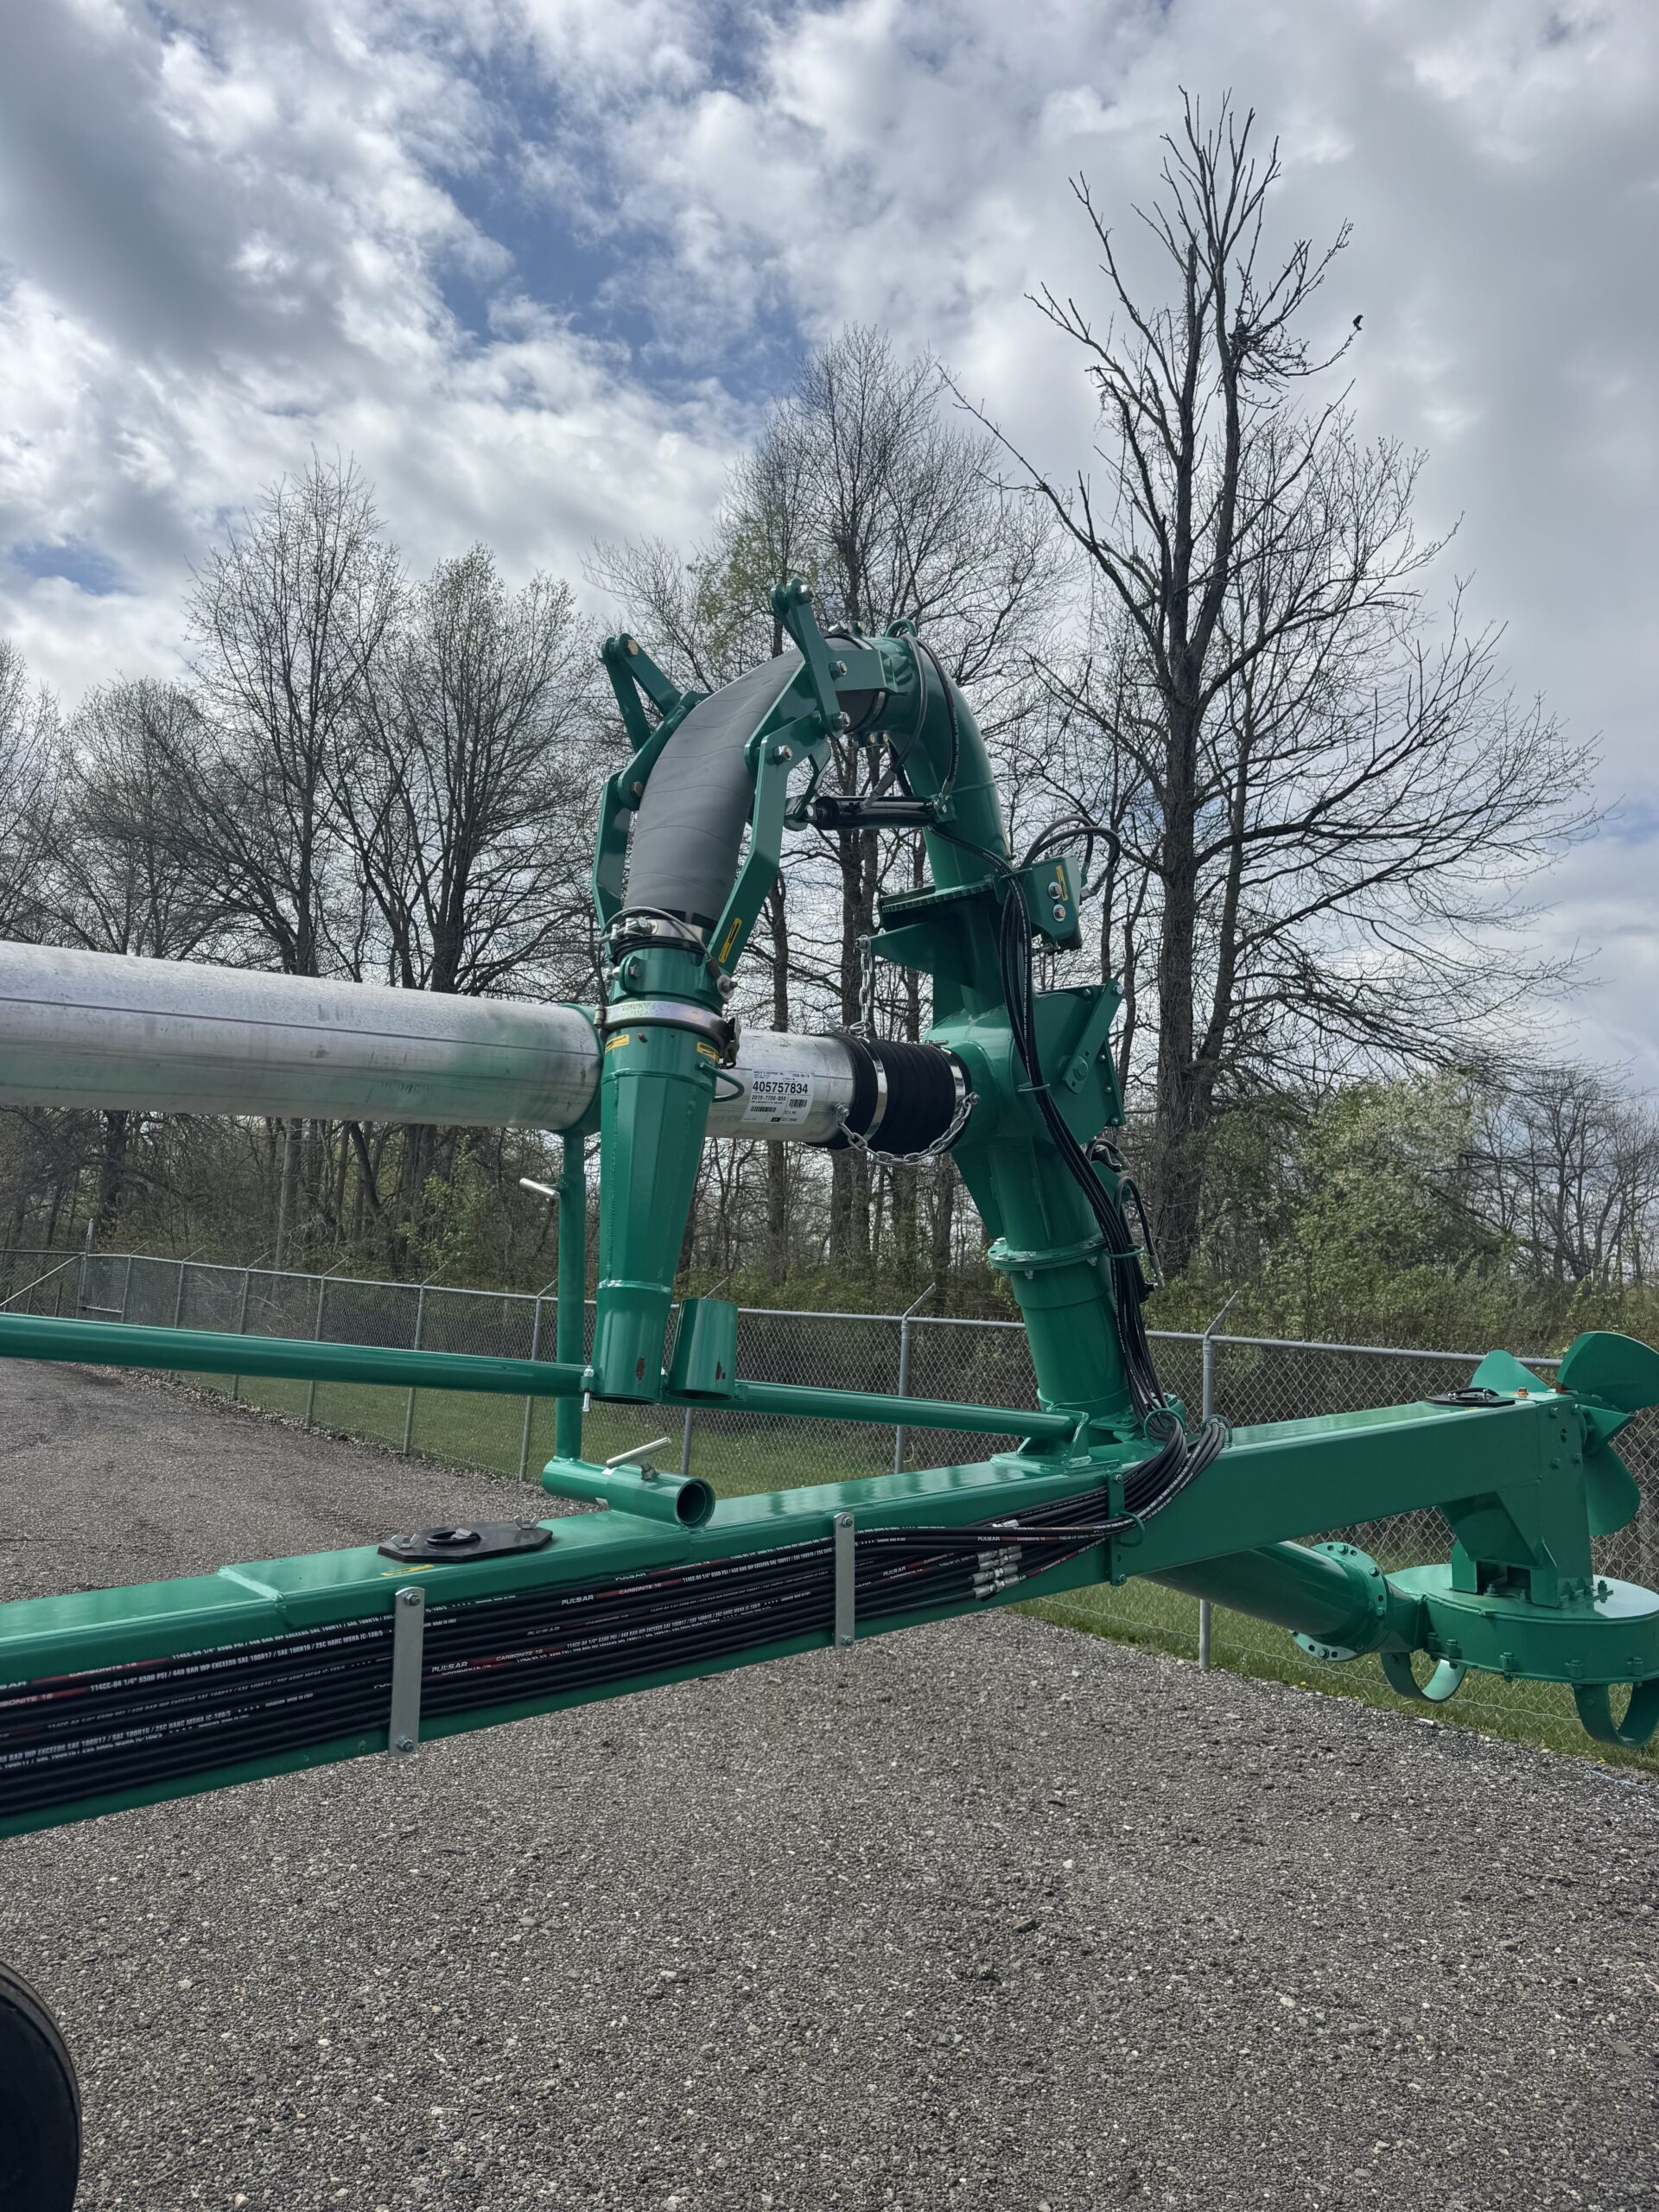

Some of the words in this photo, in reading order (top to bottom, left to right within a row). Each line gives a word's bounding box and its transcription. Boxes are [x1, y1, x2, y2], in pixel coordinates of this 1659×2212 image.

[753, 1081, 808, 1094] 405757834
[882, 1566, 906, 1576] PULSAR
[561, 1593, 594, 1605] PULSAR
[619, 1584, 652, 1595] CARBONITE
[431, 1661, 467, 1672] PULSAR
[496, 1649, 532, 1662] CARBONITE
[0, 1694, 36, 1707] BONITE
